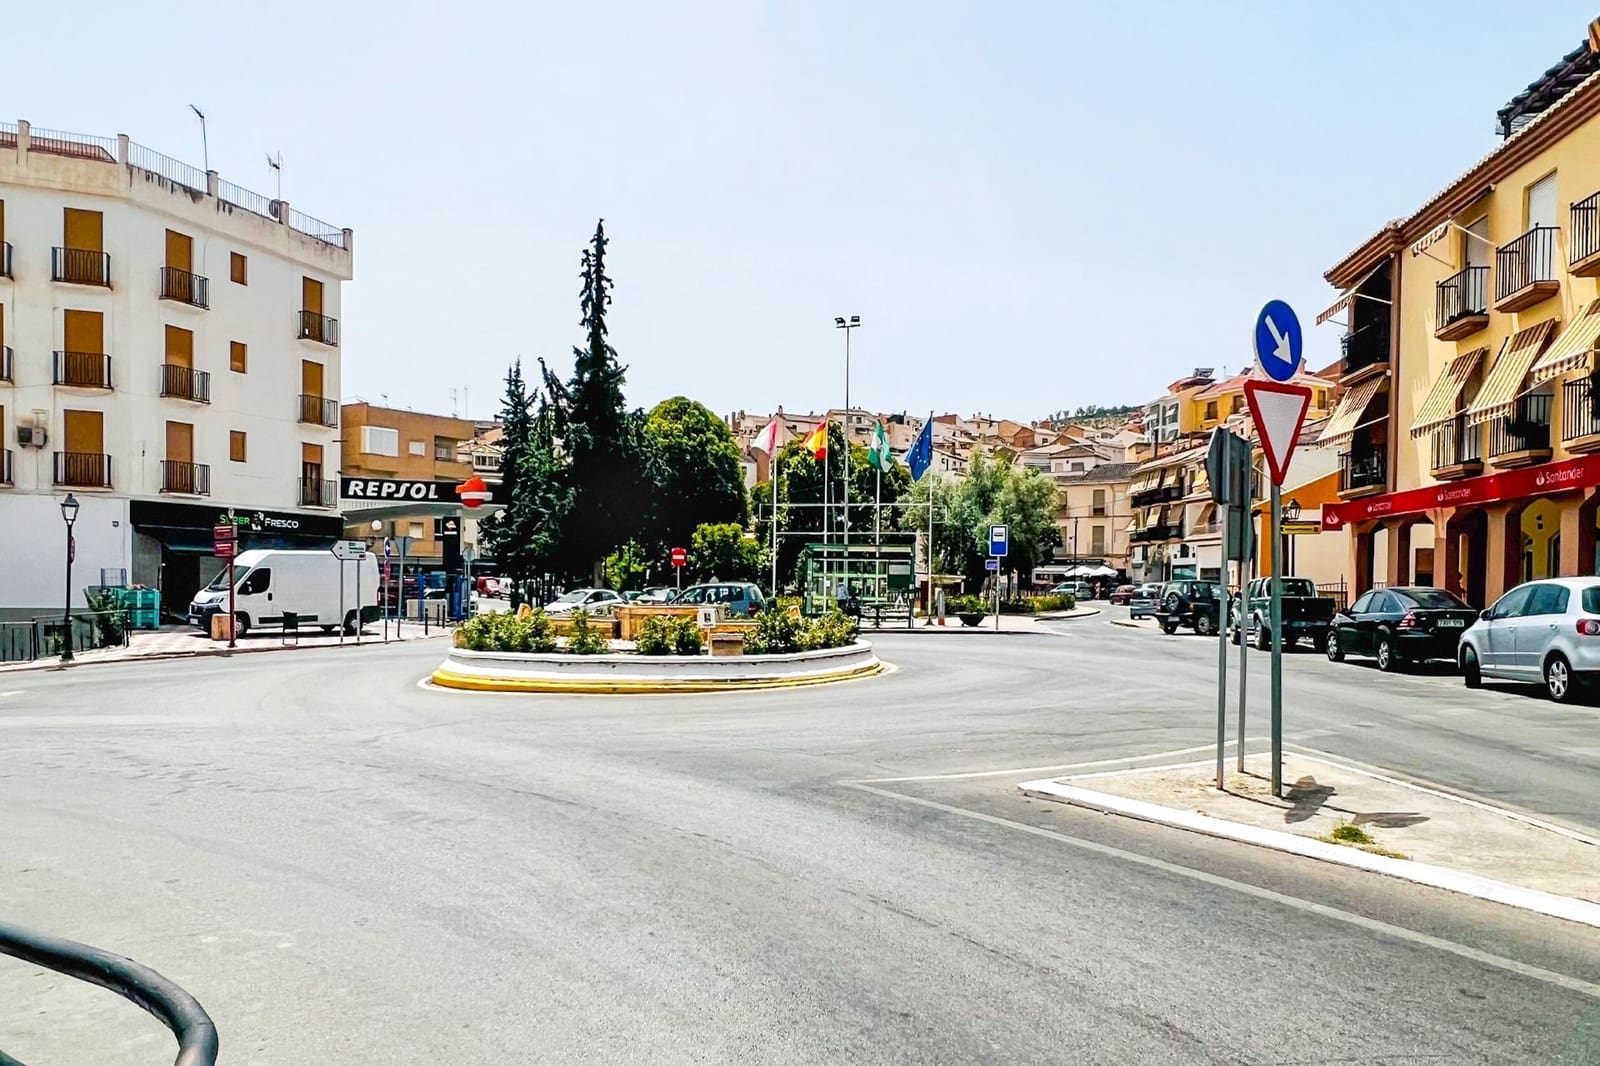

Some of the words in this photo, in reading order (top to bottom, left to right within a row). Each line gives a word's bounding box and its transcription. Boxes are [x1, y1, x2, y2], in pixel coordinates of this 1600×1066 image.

[1545, 466, 1585, 484] Santander
[348, 480, 439, 499] REPSOL
[264, 517, 299, 529] FRESCO
